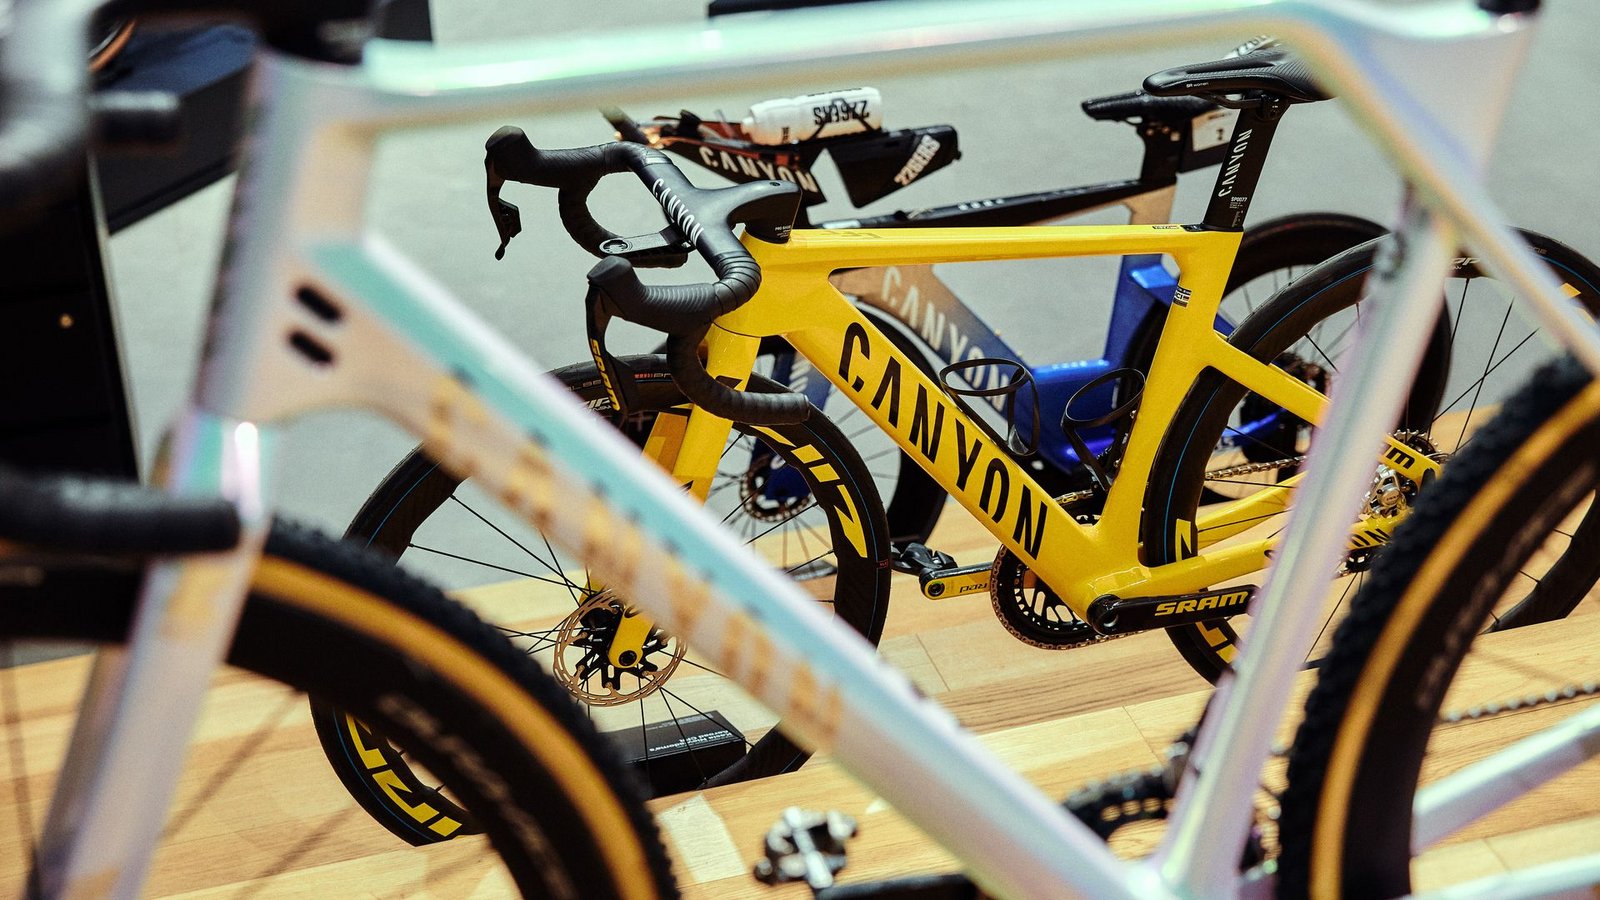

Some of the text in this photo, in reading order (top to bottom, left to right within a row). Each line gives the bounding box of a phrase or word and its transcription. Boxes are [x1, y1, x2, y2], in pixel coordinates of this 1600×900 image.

[699, 146, 818, 193] CANYON
[1218, 128, 1253, 197] CANYON
[652, 178, 704, 247] CANYON
[881, 265, 1009, 411] CANYON
[838, 321, 1048, 561] CANYON
[1154, 591, 1249, 617] SRAM
